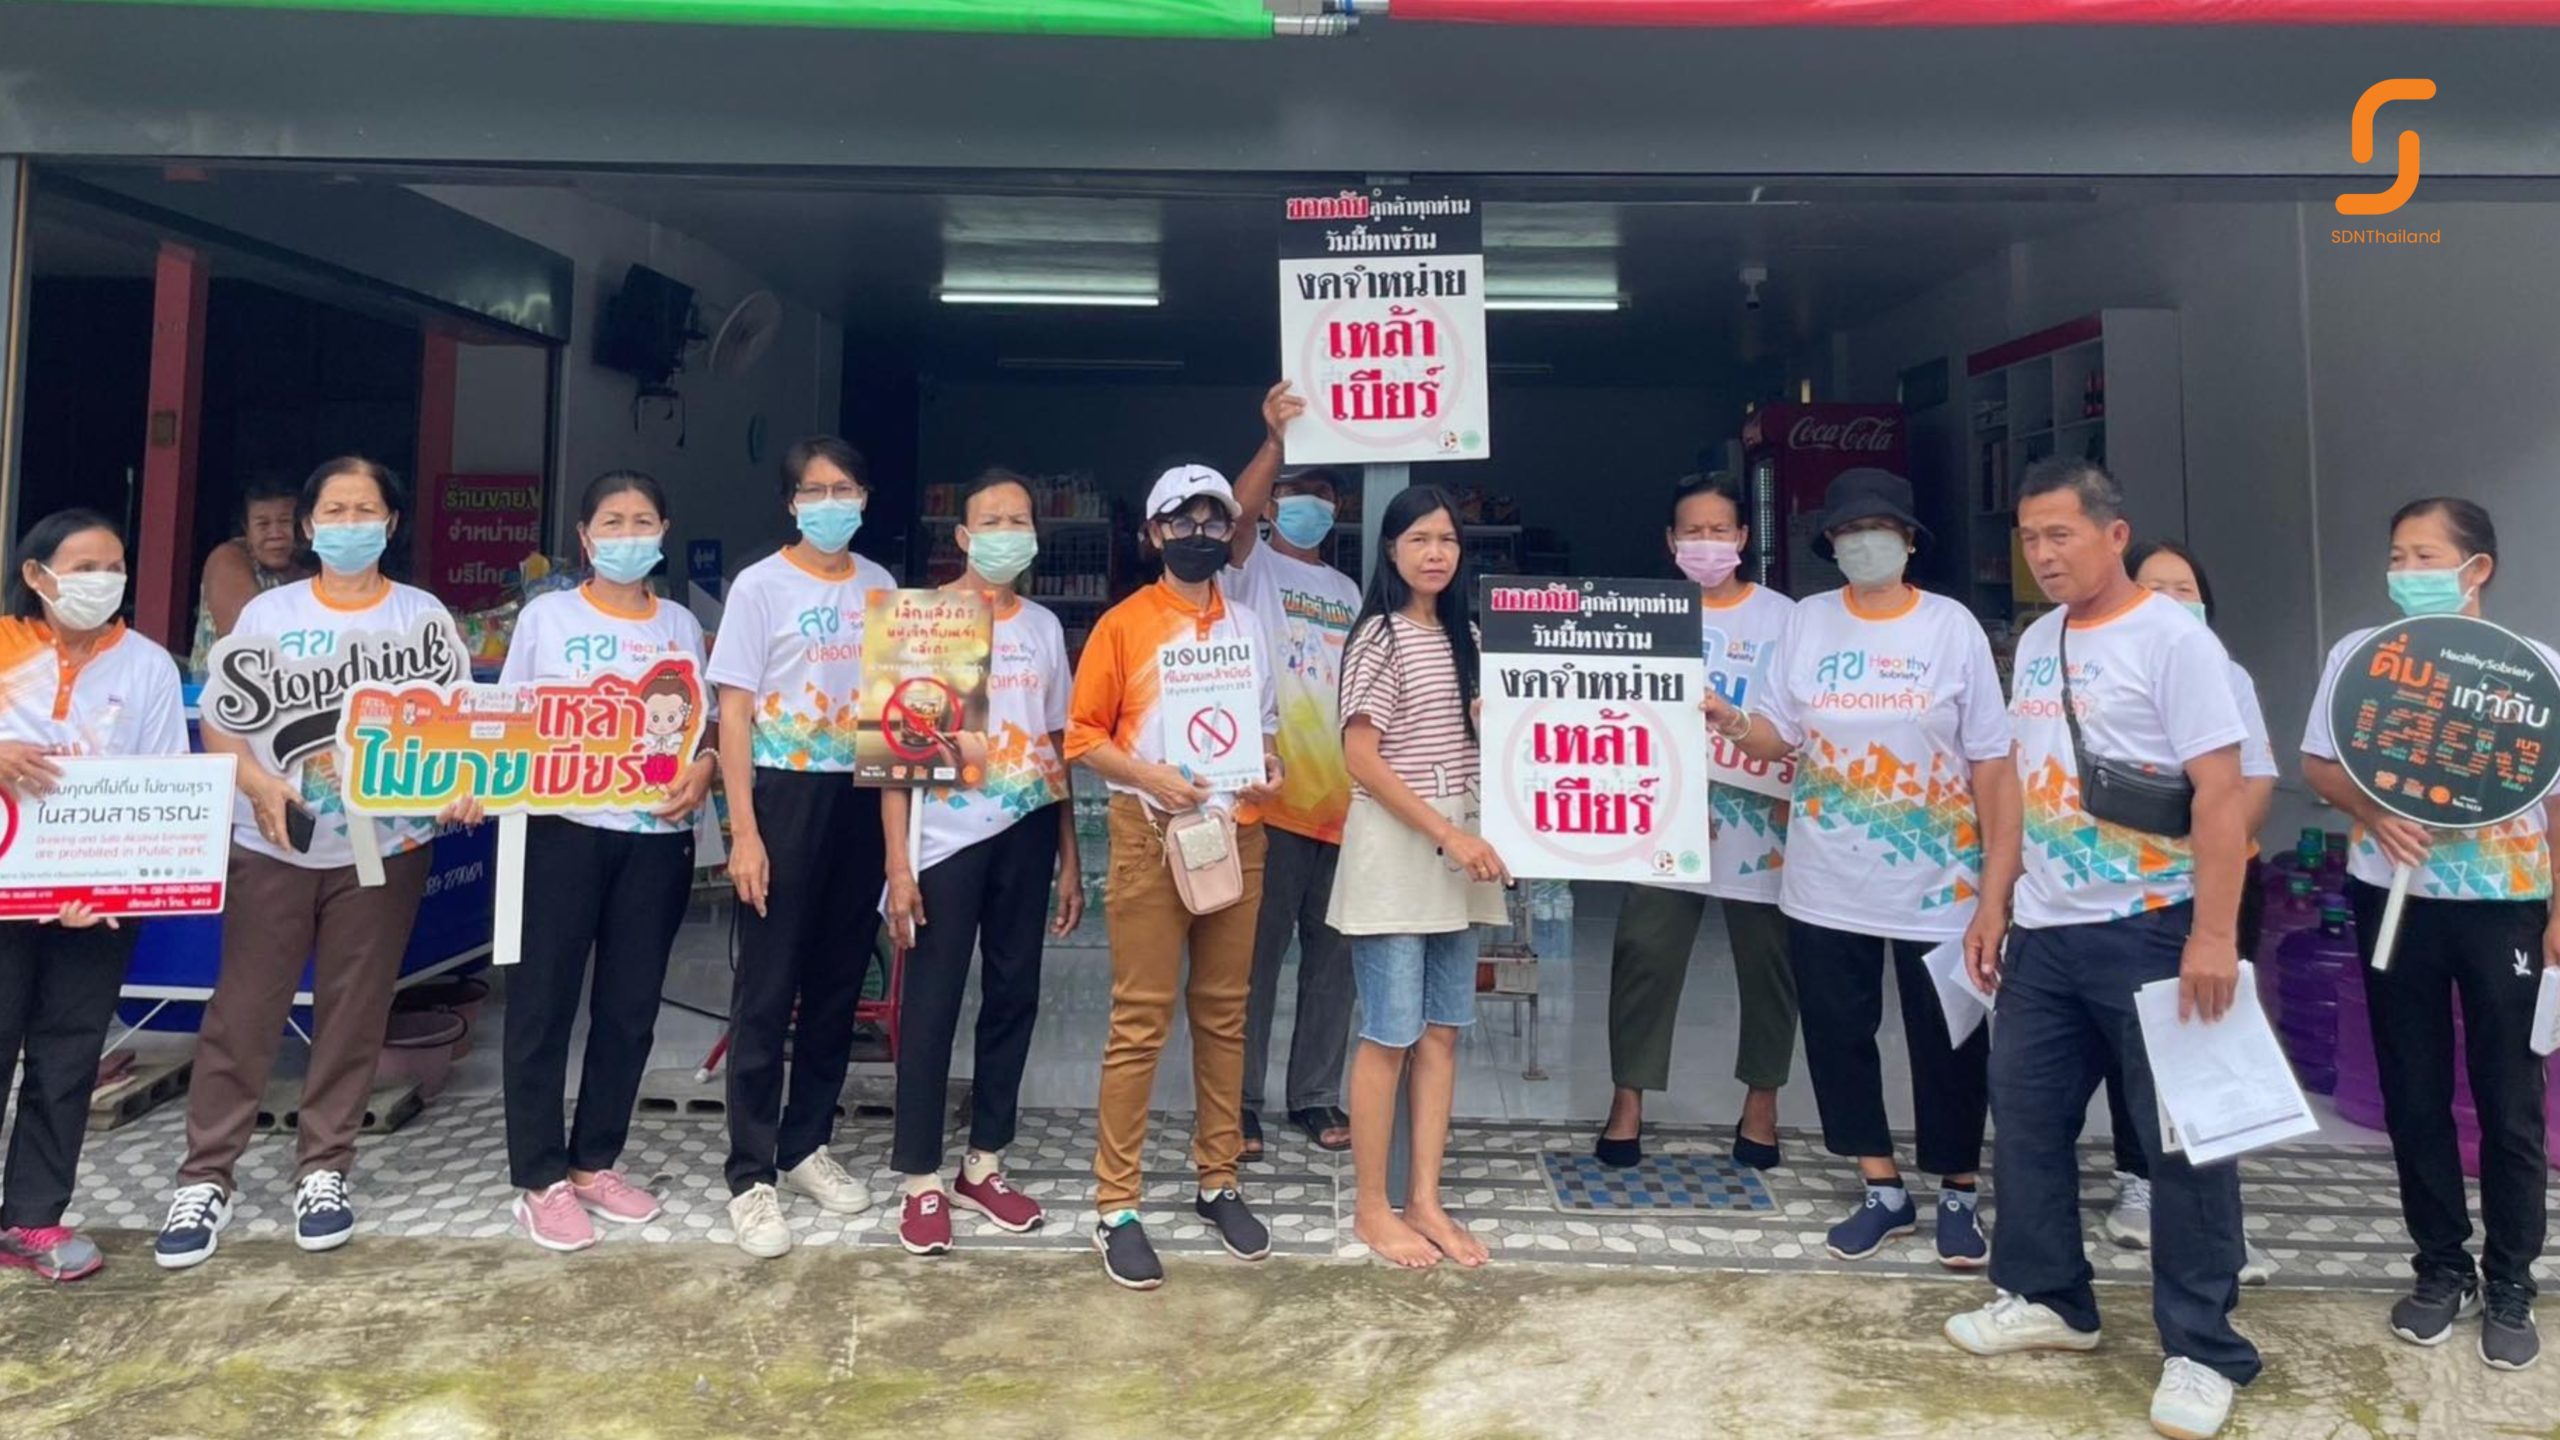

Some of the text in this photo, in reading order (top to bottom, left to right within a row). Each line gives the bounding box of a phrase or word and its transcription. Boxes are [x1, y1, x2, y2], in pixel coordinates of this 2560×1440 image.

[1325, 224, 1437, 251] วันนี้ทางร้าน
[1297, 263, 1467, 300] งดจำหน่าย
[1329, 304, 1437, 359] เหล้า
[1330, 366, 1445, 421] เบียร์
[1788, 415, 1897, 451] Coca-Cola
[799, 606, 839, 645] สุข
[1532, 619, 1652, 650] วันนี้ทางร้าน
[565, 634, 617, 671] สุข
[1162, 643, 1250, 667] ขอบคุณ
[1817, 650, 1865, 692] สุข
[2368, 632, 2434, 688] ดื่ม
[216, 621, 453, 727] Stopdrink
[1501, 663, 1684, 702] งดจำหน่าย
[539, 683, 647, 738] เหล้า
[1810, 687, 1927, 710] ปลอดเหล้า
[2452, 683, 2550, 728] เท่ากับ
[1533, 708, 1650, 767] เหล้า
[356, 727, 648, 797] ไม่ขาย เบียร์
[144, 779, 212, 796] ไม่ขายสุรา
[1534, 777, 1659, 836] เบียร์
[37, 801, 209, 824] ในสวนสาธารณะ
